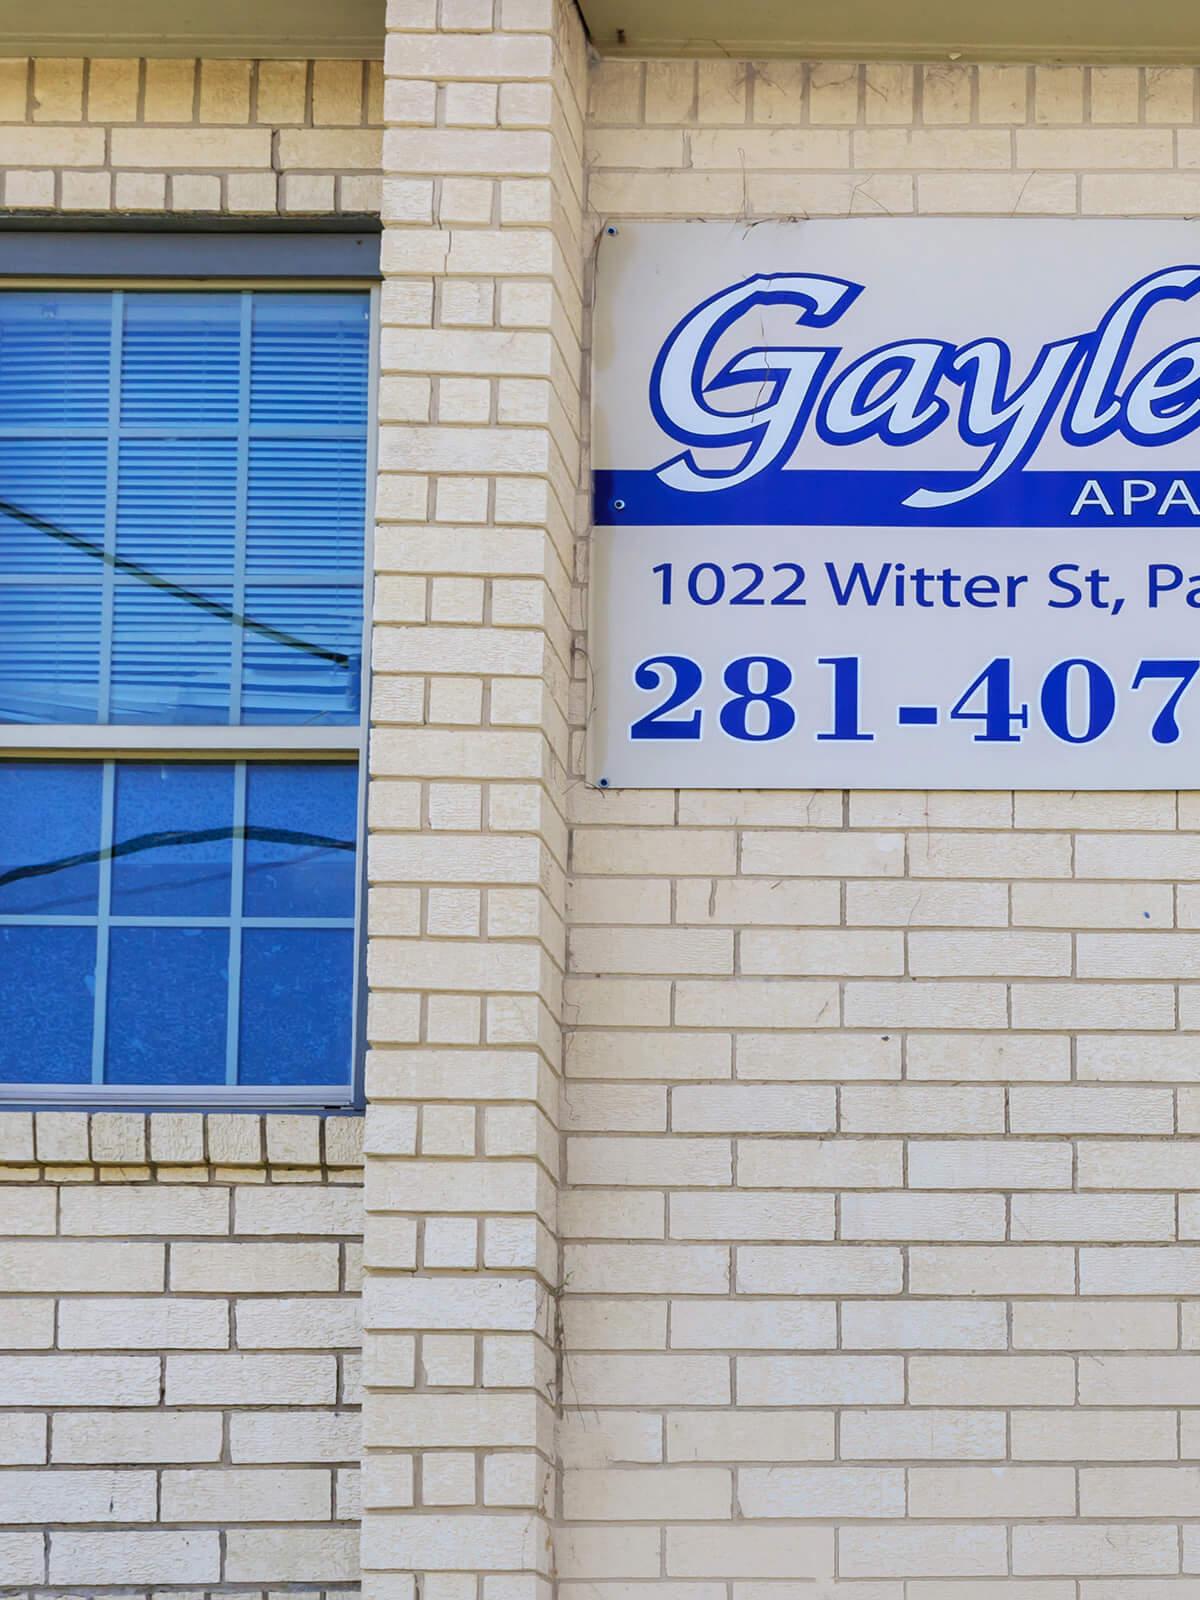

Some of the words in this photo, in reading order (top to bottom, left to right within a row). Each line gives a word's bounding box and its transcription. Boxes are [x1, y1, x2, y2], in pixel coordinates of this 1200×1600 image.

[652, 562, 807, 607] 1022
[824, 561, 1029, 609] Witter
[1047, 563, 1126, 616] St,
